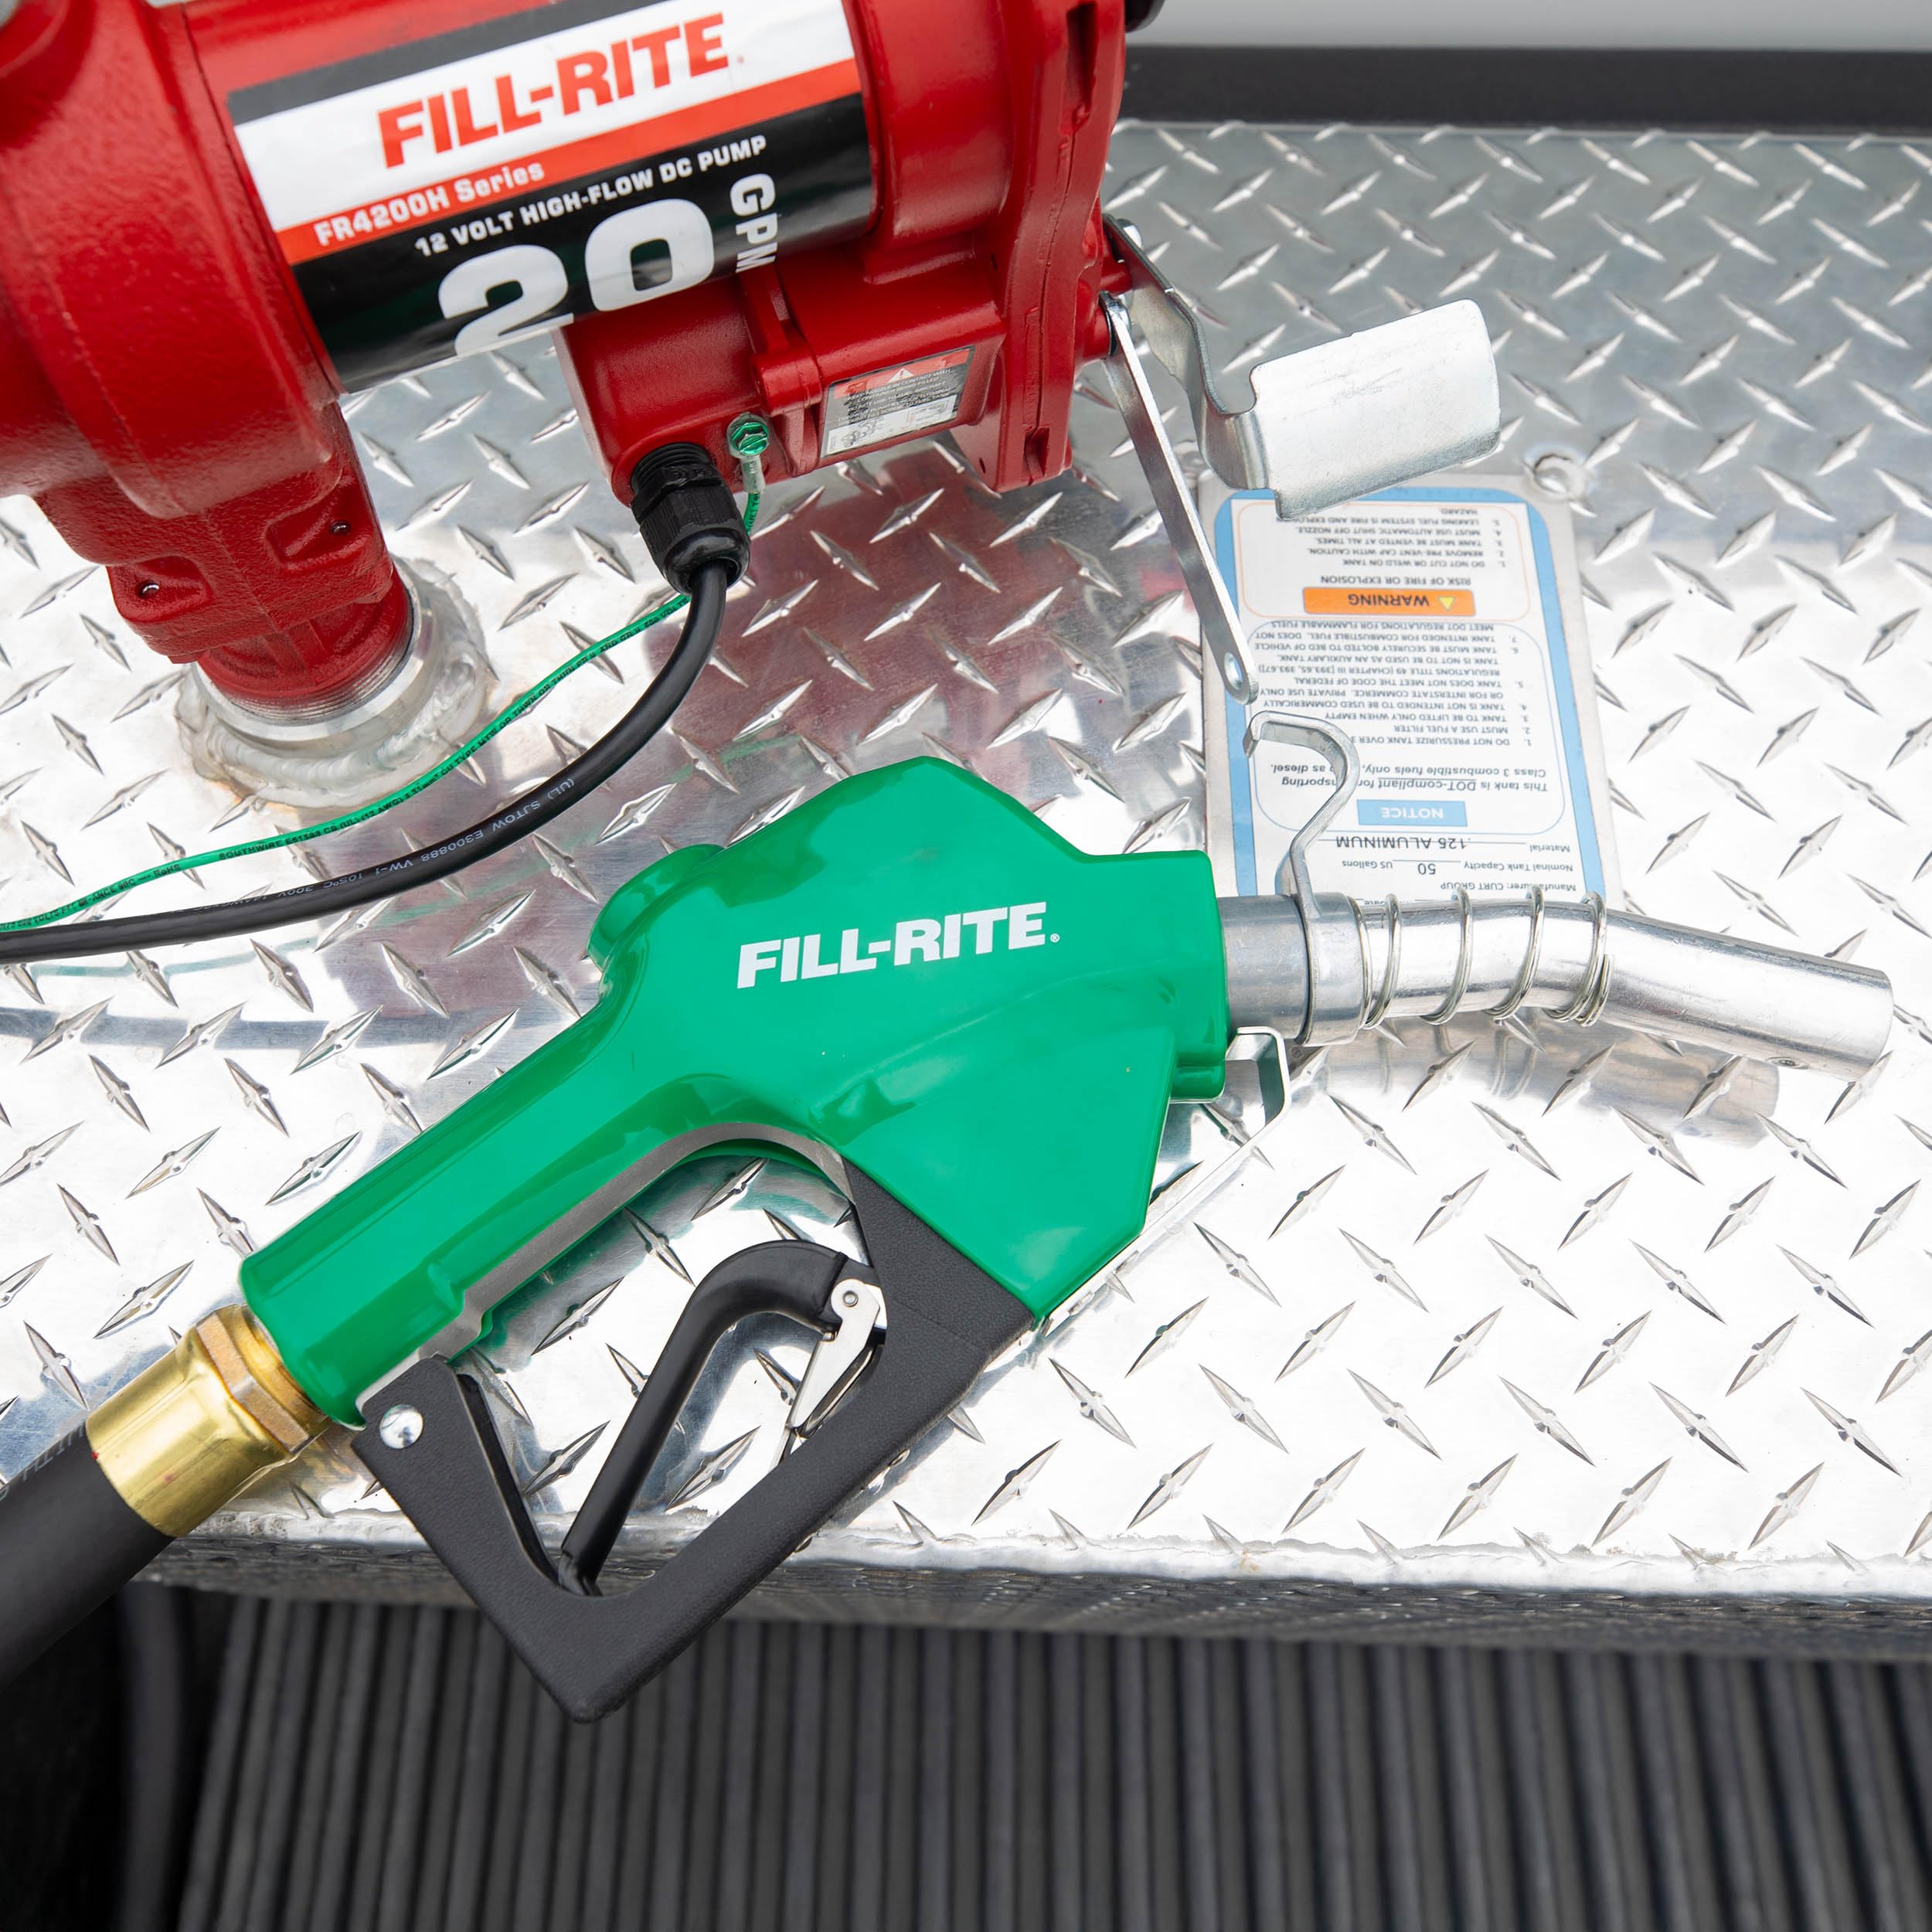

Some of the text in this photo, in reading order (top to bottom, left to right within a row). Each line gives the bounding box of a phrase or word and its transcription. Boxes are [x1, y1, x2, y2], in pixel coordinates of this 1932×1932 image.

[414, 134, 767, 257] 12 VOLT HIGH-FLOW DC PUMP
[314, 162, 544, 247] FR4200H Series
[730, 173, 778, 274] GPM
[438, 199, 714, 357] 20
[1263, 699, 1338, 708] COMMERICALLY
[1270, 764, 1308, 774] diesel.
[1362, 764, 1390, 774] only,
[1394, 766, 1423, 775] fuels
[1426, 767, 1499, 777] combustible
[1502, 768, 1509, 777] 3
[1513, 768, 1546, 777] Class
[1358, 776, 1374, 788] for
[1376, 777, 1477, 791] DOT-compliant
[1480, 781, 1490, 790] is
[1494, 781, 1519, 791] tank
[1522, 782, 1547, 791] This
[548, 778, 575, 799] (UL)
[492, 800, 540, 832] SJTOW
[1381, 807, 1444, 818] NOTICE
[420, 829, 484, 862] E300888
[1335, 835, 1432, 849] ALUMINUM
[1529, 844, 1570, 852] Material
[375, 859, 414, 876] VW-1
[1342, 860, 1377, 869] Gallons
[1417, 862, 1436, 875] 50
[1463, 860, 1505, 871] Capacity
[1532, 863, 1573, 872] Nominal
[1477, 882, 1503, 890] CURT
[1506, 883, 1576, 893] Manufaurer:
